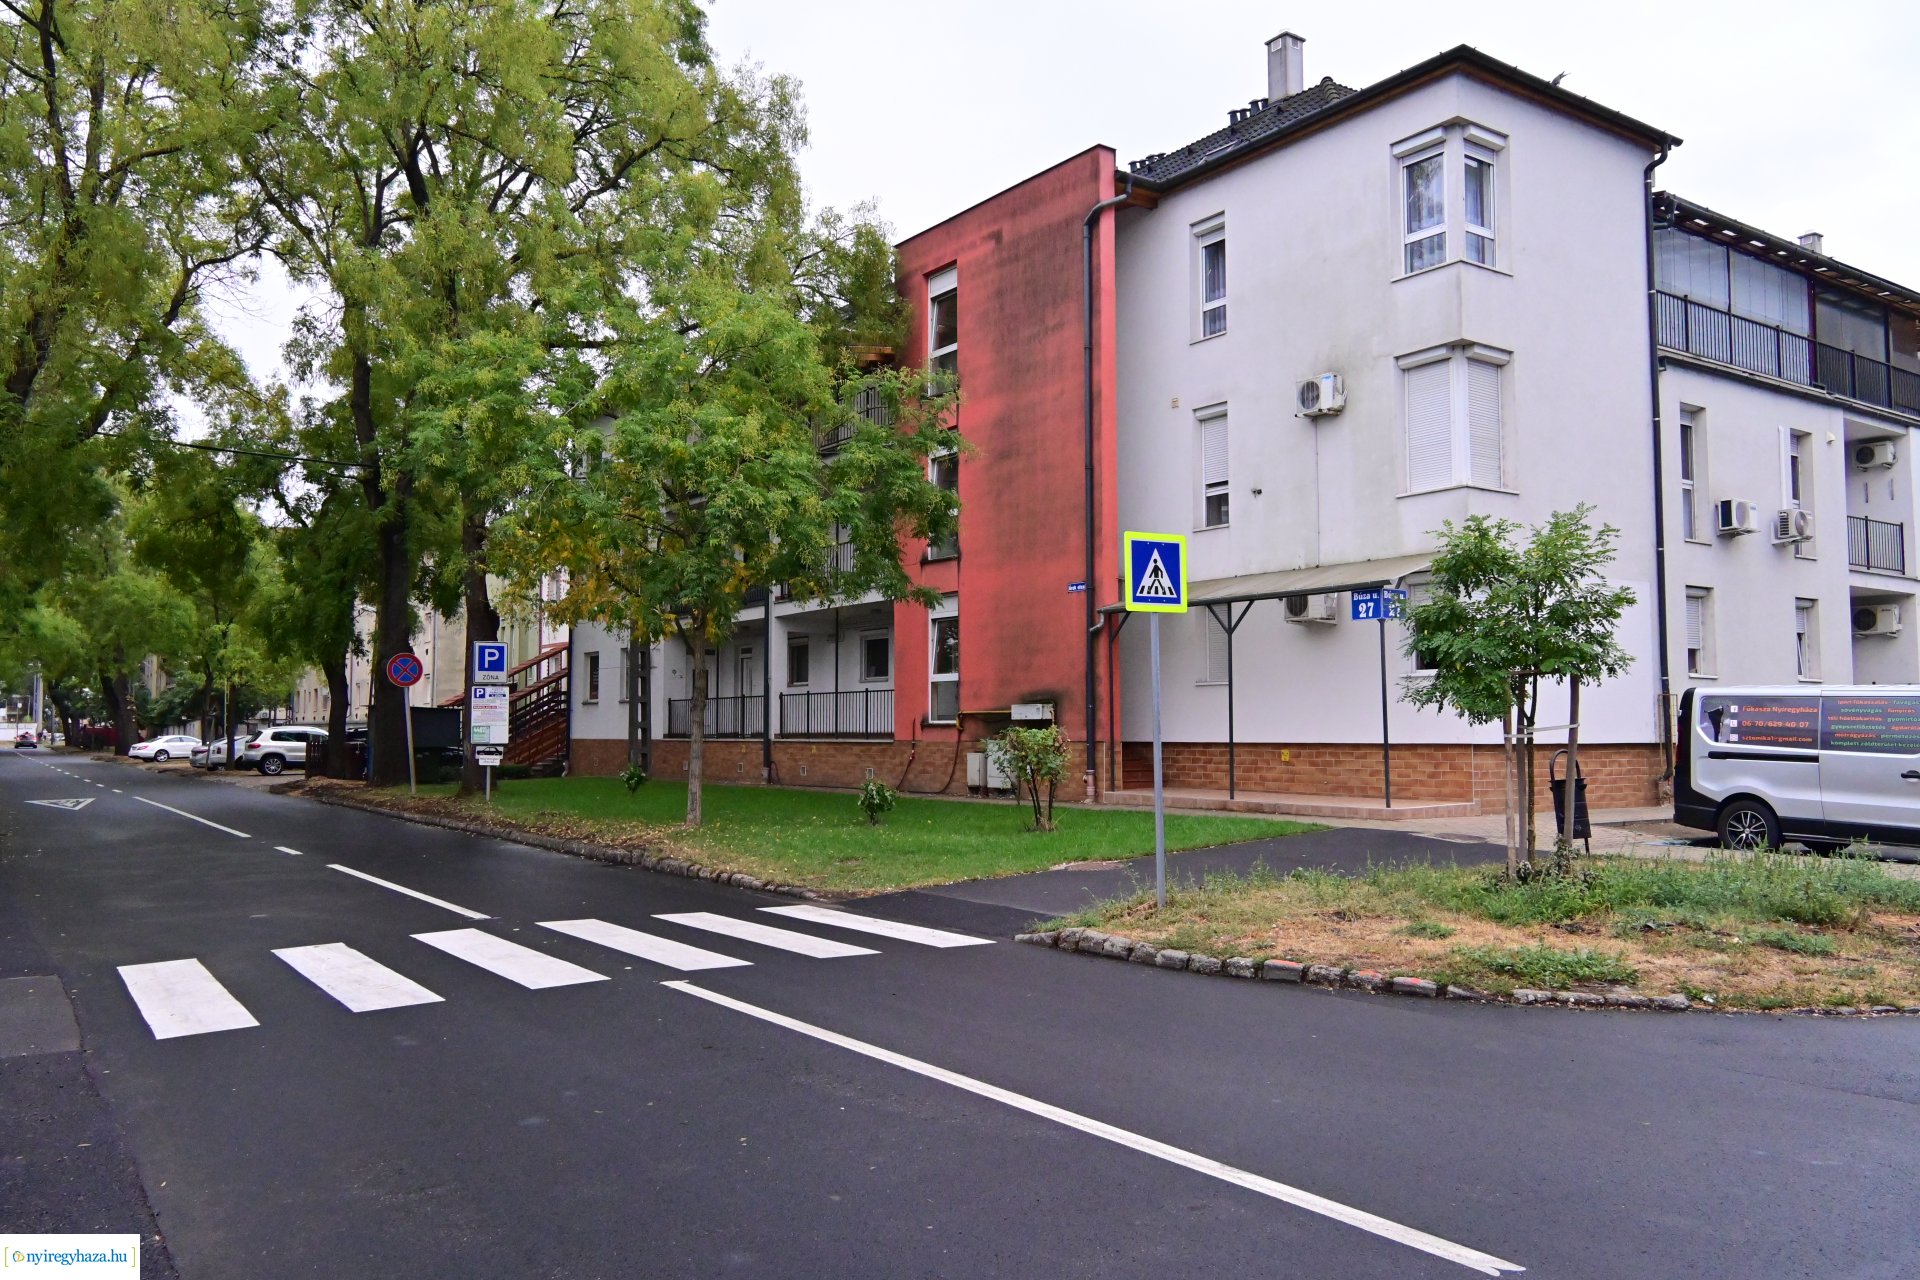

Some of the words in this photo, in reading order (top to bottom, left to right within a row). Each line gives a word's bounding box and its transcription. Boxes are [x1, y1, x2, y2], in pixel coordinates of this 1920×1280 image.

[1353, 592, 1370, 600] Búza
[1358, 601, 1375, 618] 27
[484, 648, 500, 669] P
